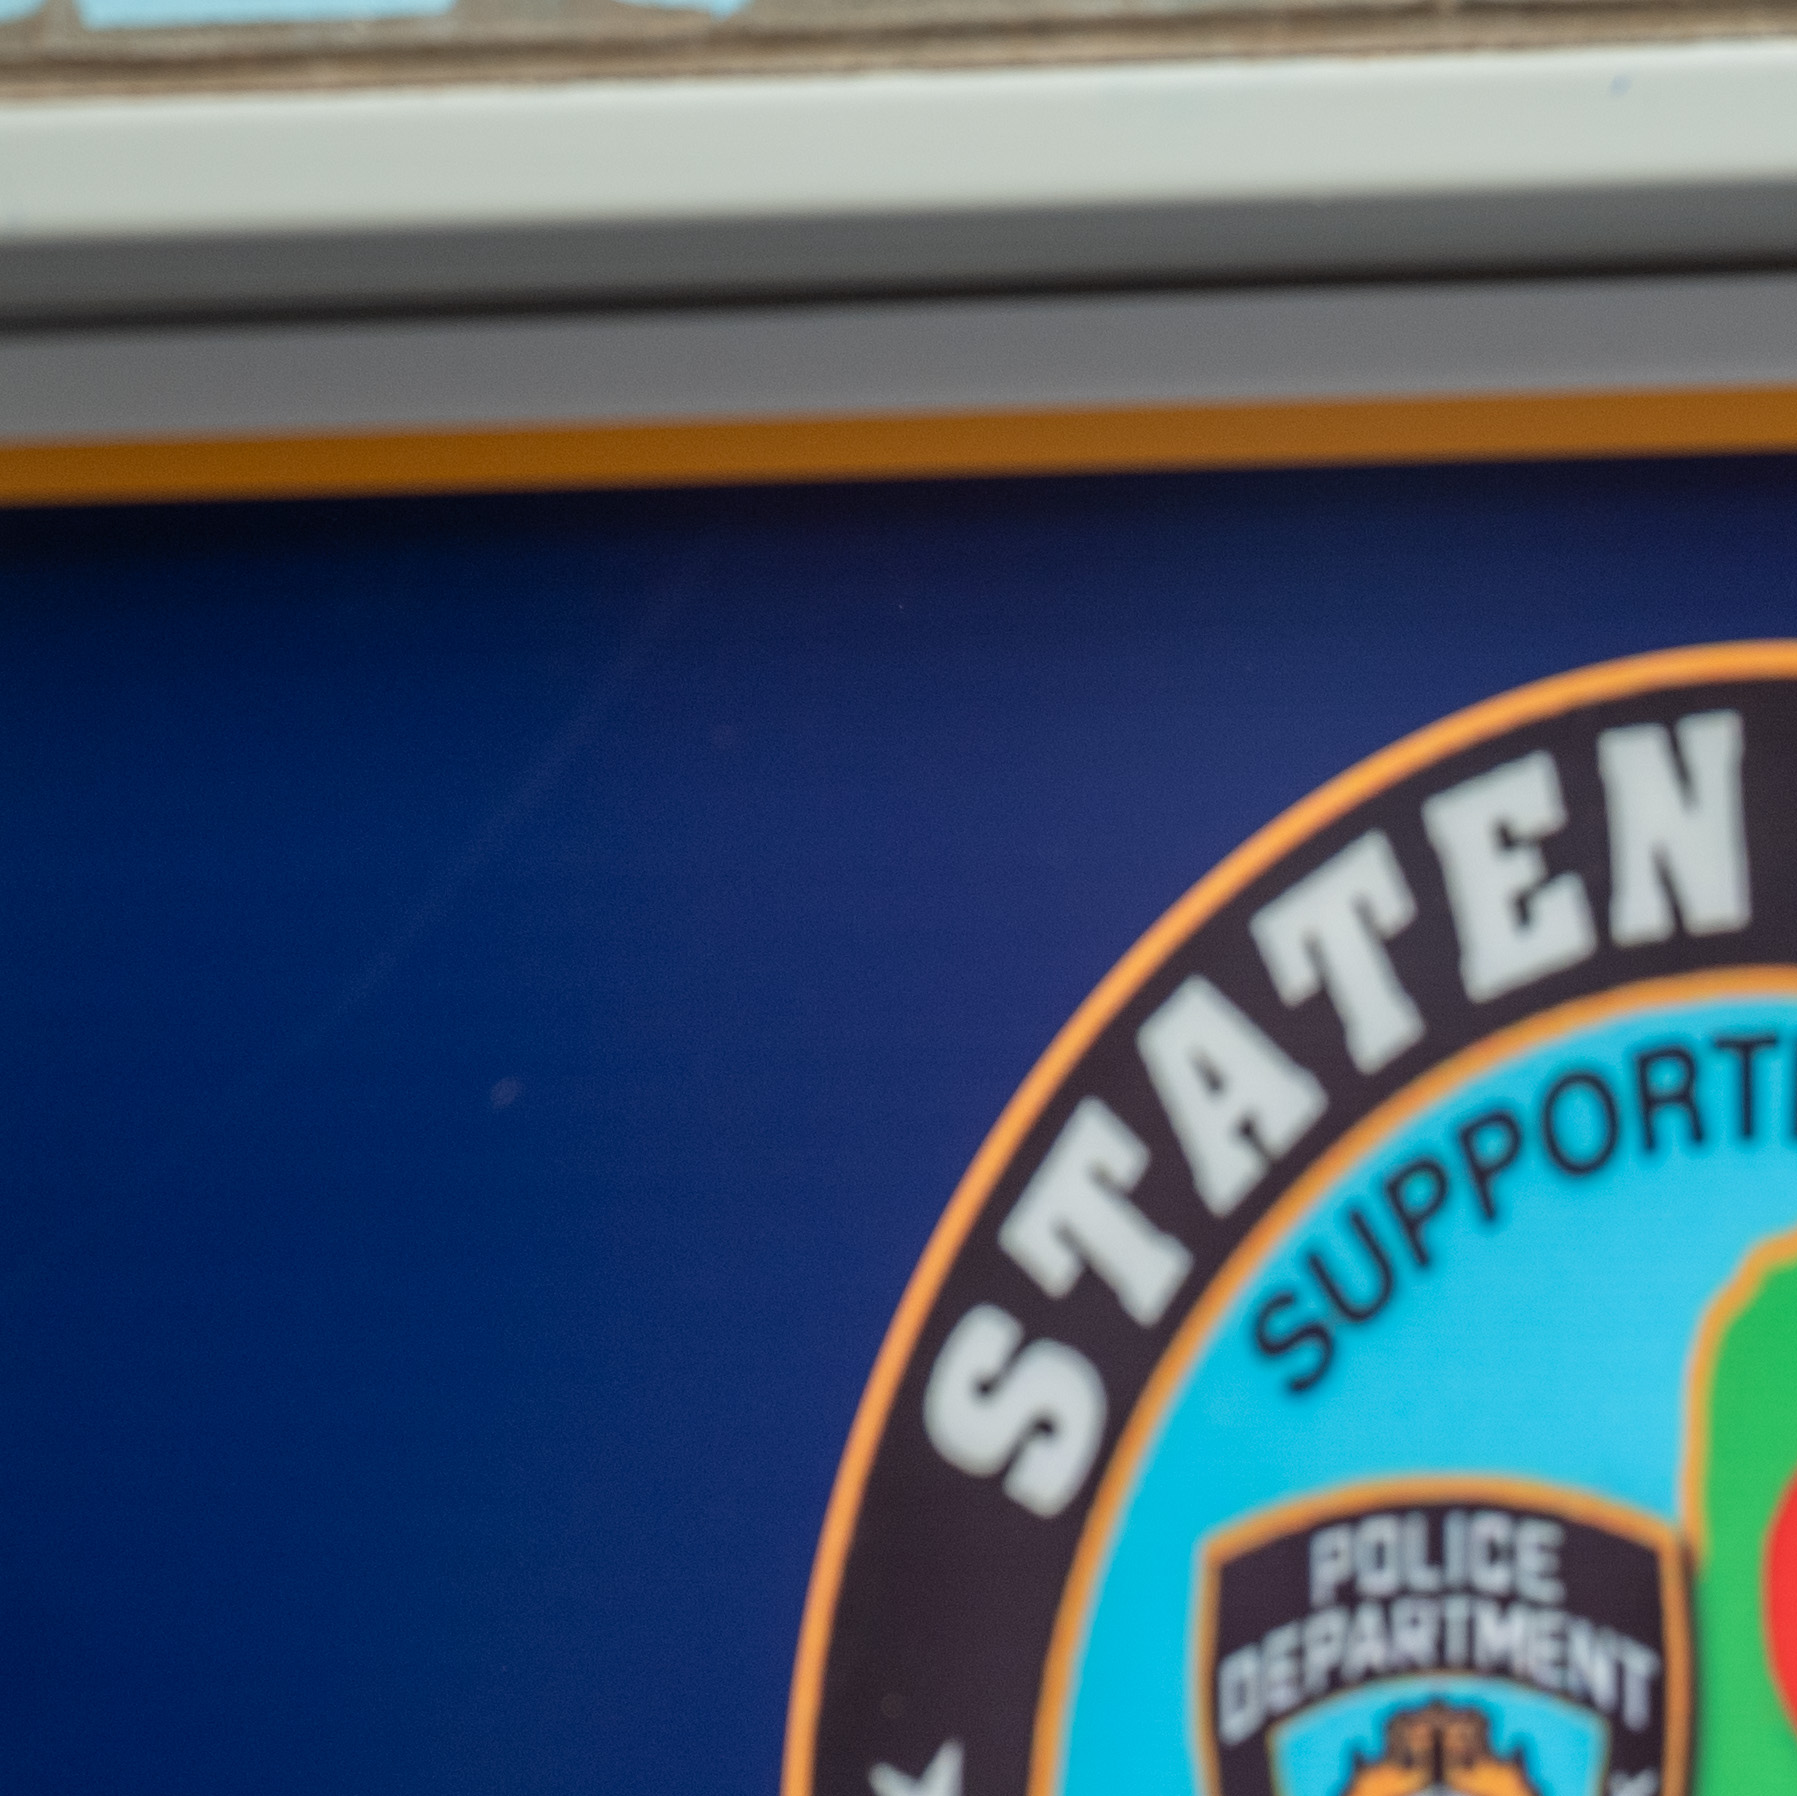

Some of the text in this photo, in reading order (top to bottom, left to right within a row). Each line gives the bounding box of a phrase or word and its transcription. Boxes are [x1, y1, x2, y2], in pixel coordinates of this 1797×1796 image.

[922, 707, 1751, 1518] STATEN
[1308, 1510, 1568, 1608] POLICE
[1217, 1599, 1662, 1746] DEPARTMENT
